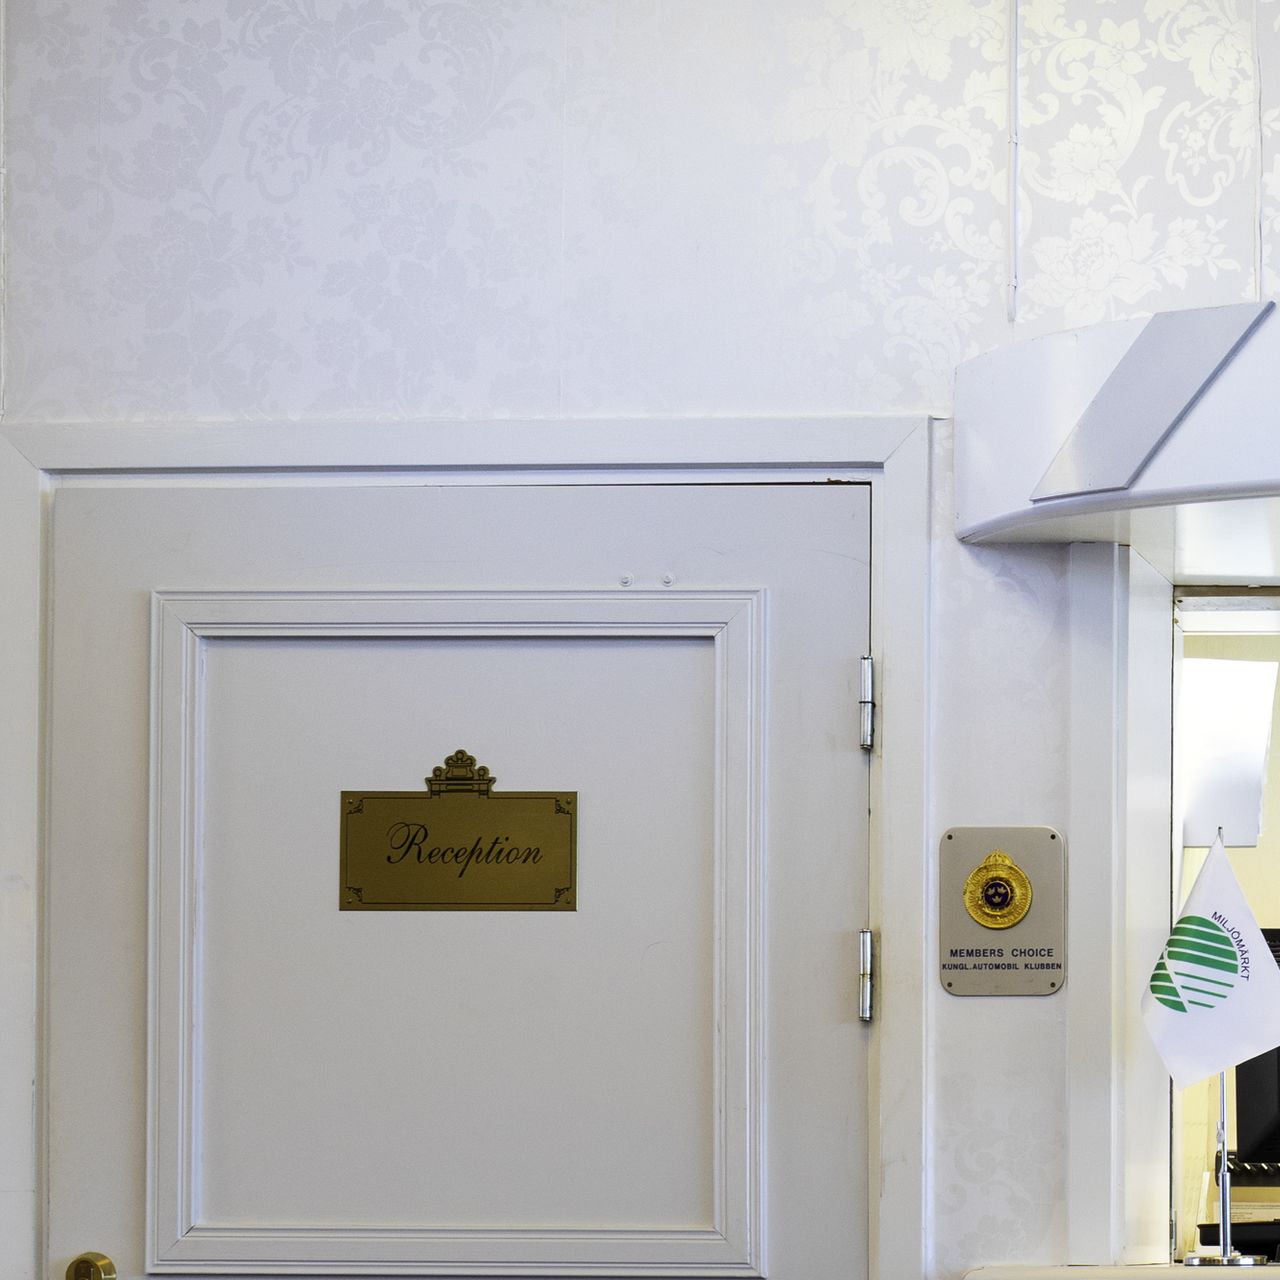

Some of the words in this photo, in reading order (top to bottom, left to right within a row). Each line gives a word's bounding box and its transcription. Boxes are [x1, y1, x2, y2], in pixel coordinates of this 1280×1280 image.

[386, 822, 543, 878] Reception
[949, 949, 1004, 958] MEMBERS
[1011, 948, 1054, 957] CHOICE
[1211, 911, 1250, 981] MILJÖMÄRKT
